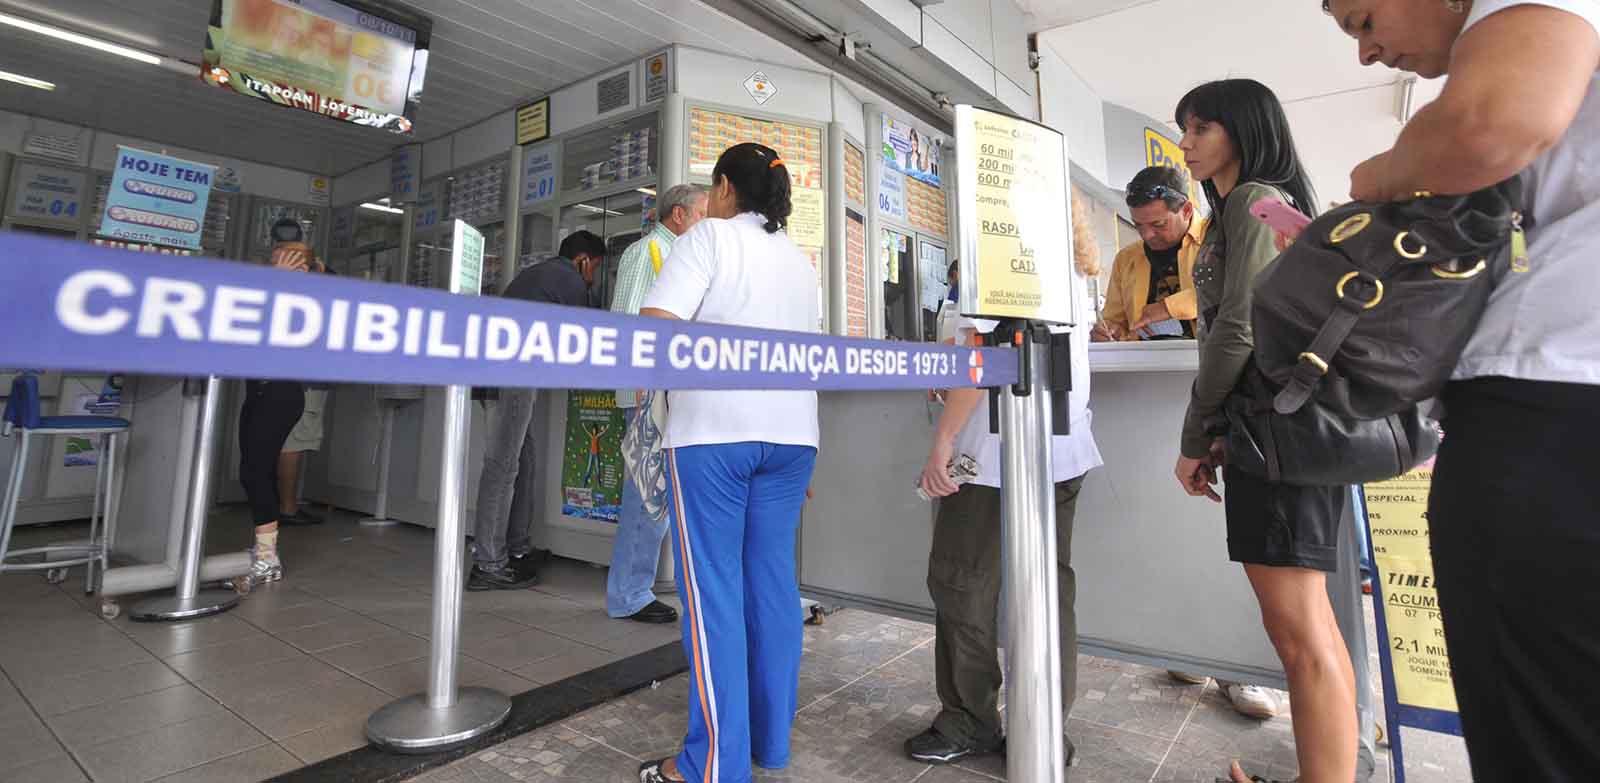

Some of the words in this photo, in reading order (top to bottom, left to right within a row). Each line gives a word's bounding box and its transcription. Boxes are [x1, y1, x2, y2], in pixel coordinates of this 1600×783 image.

[245, 78, 313, 105] ITAPOAN
[981, 143, 994, 154] 60
[121, 156, 168, 176] HOJE
[175, 168, 208, 185] TEM
[979, 158, 999, 170] 200
[978, 173, 999, 185] 600
[879, 193, 889, 212] 06
[55, 269, 617, 366] CREDIBILIDADE
[630, 331, 656, 368] E
[667, 334, 841, 381] CONFIANÇA
[845, 350, 908, 377] DESDE
[912, 353, 949, 376] 1973
[1393, 637, 1419, 654] 2,1
